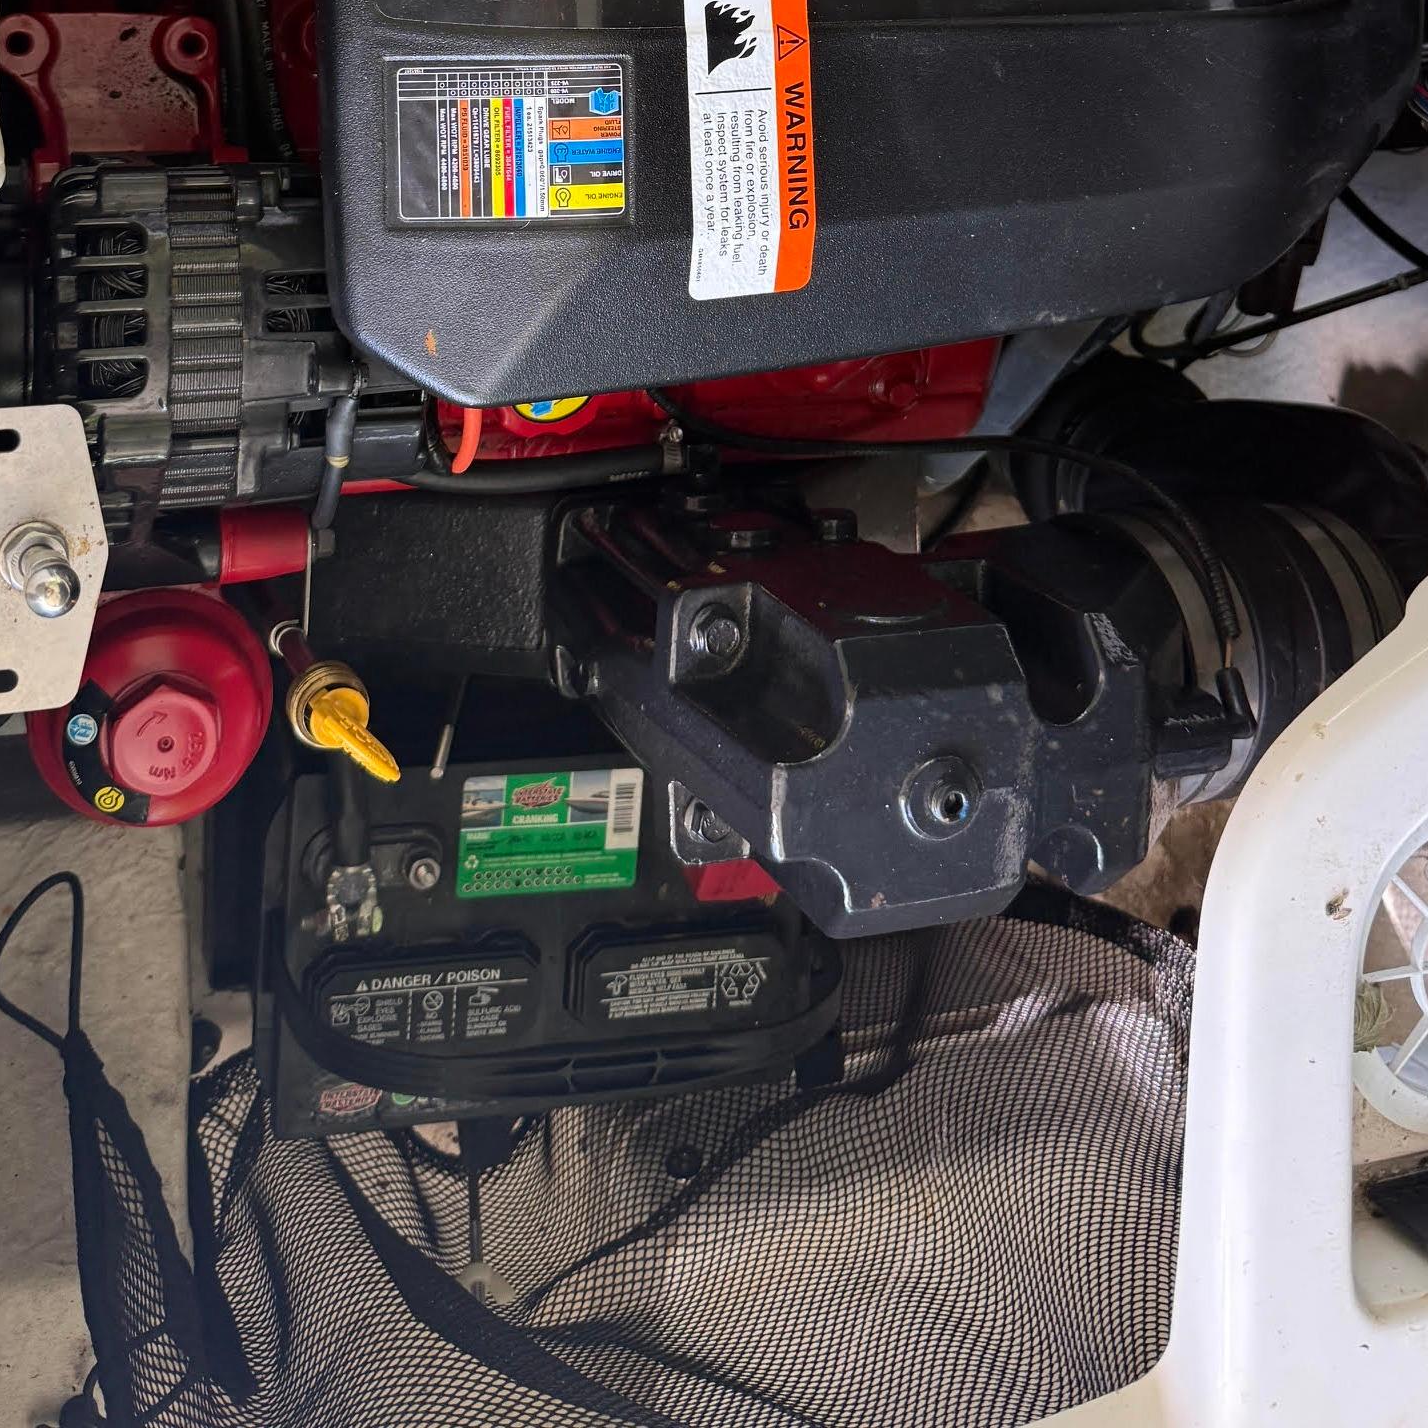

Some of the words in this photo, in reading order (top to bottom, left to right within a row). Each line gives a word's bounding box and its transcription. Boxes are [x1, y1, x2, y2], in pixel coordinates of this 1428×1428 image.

[703, 113, 712, 124] at
[744, 109, 754, 136] from
[758, 109, 769, 142] Avoid
[703, 128, 714, 157] least
[715, 112, 727, 155] Inspect
[730, 111, 741, 162] resulting
[745, 141, 755, 159] fire
[784, 81, 810, 230] WARNING
[589, 170, 601, 178] OIL
[602, 170, 622, 178] DRIVE
[705, 160, 714, 190] once
[716, 160, 729, 203] system
[733, 166, 742, 193] from
[746, 163, 754, 175] or
[759, 146, 770, 190] serious
[585, 193, 597, 201] OIL
[598, 192, 622, 200] ENGINE
[706, 194, 714, 202] a
[746, 179, 757, 240] explosion,
[759, 194, 771, 226] injury
[720, 207, 730, 223] for
[732, 197, 744, 240] leaking
[719, 226, 731, 257] leaks
[761, 230, 770, 241] or
[757, 245, 770, 276] death
[372, 974, 431, 990] DANGER
[447, 969, 500, 983] POISON
